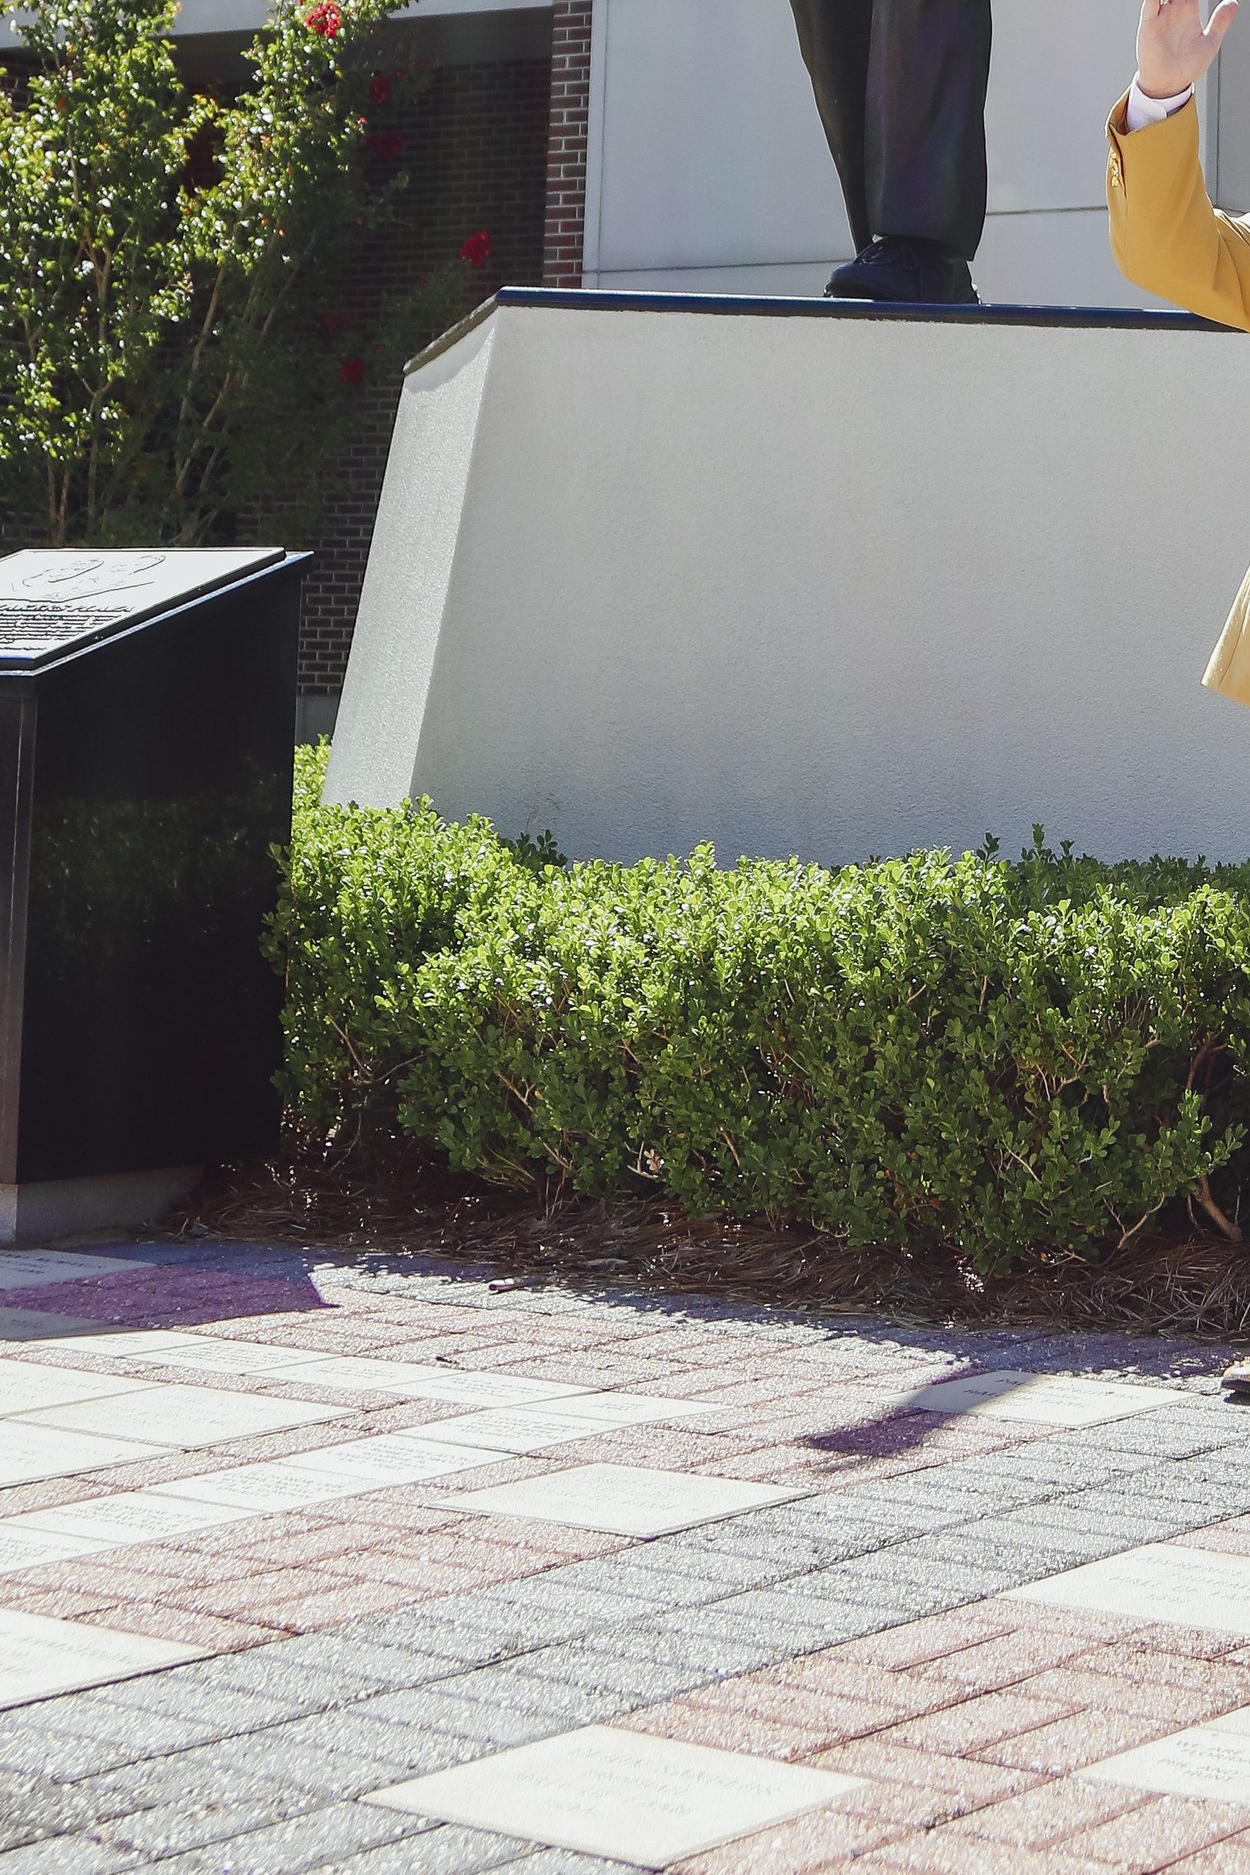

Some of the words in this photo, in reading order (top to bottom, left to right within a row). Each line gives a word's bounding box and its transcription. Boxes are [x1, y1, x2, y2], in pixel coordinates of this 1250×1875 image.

[1170, 1740, 1203, 1748] WE
[1204, 1745, 1248, 1756] ARE
[1193, 1764, 1246, 1776] AND
